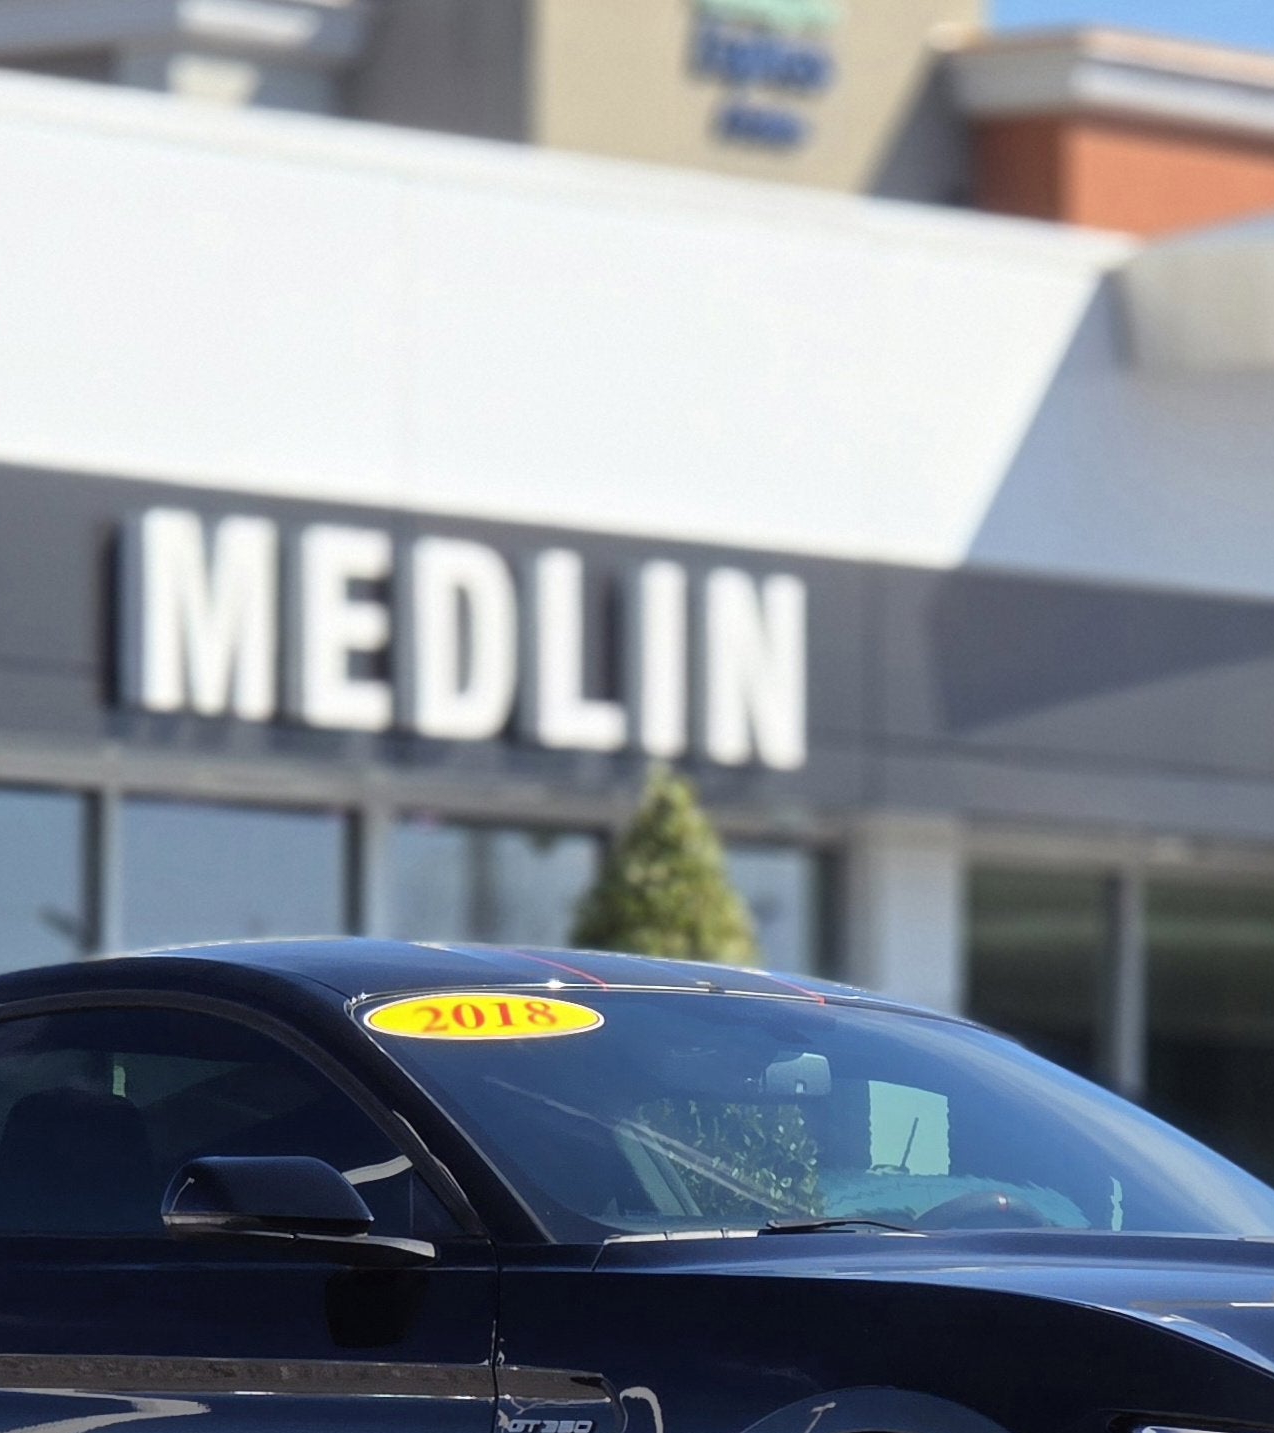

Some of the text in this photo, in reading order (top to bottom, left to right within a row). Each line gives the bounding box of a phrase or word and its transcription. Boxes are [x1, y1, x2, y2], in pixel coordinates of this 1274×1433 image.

[141, 506, 807, 770] MEDLIN
[415, 1000, 557, 1033] 2018
[507, 1419, 593, 1433] GT350
